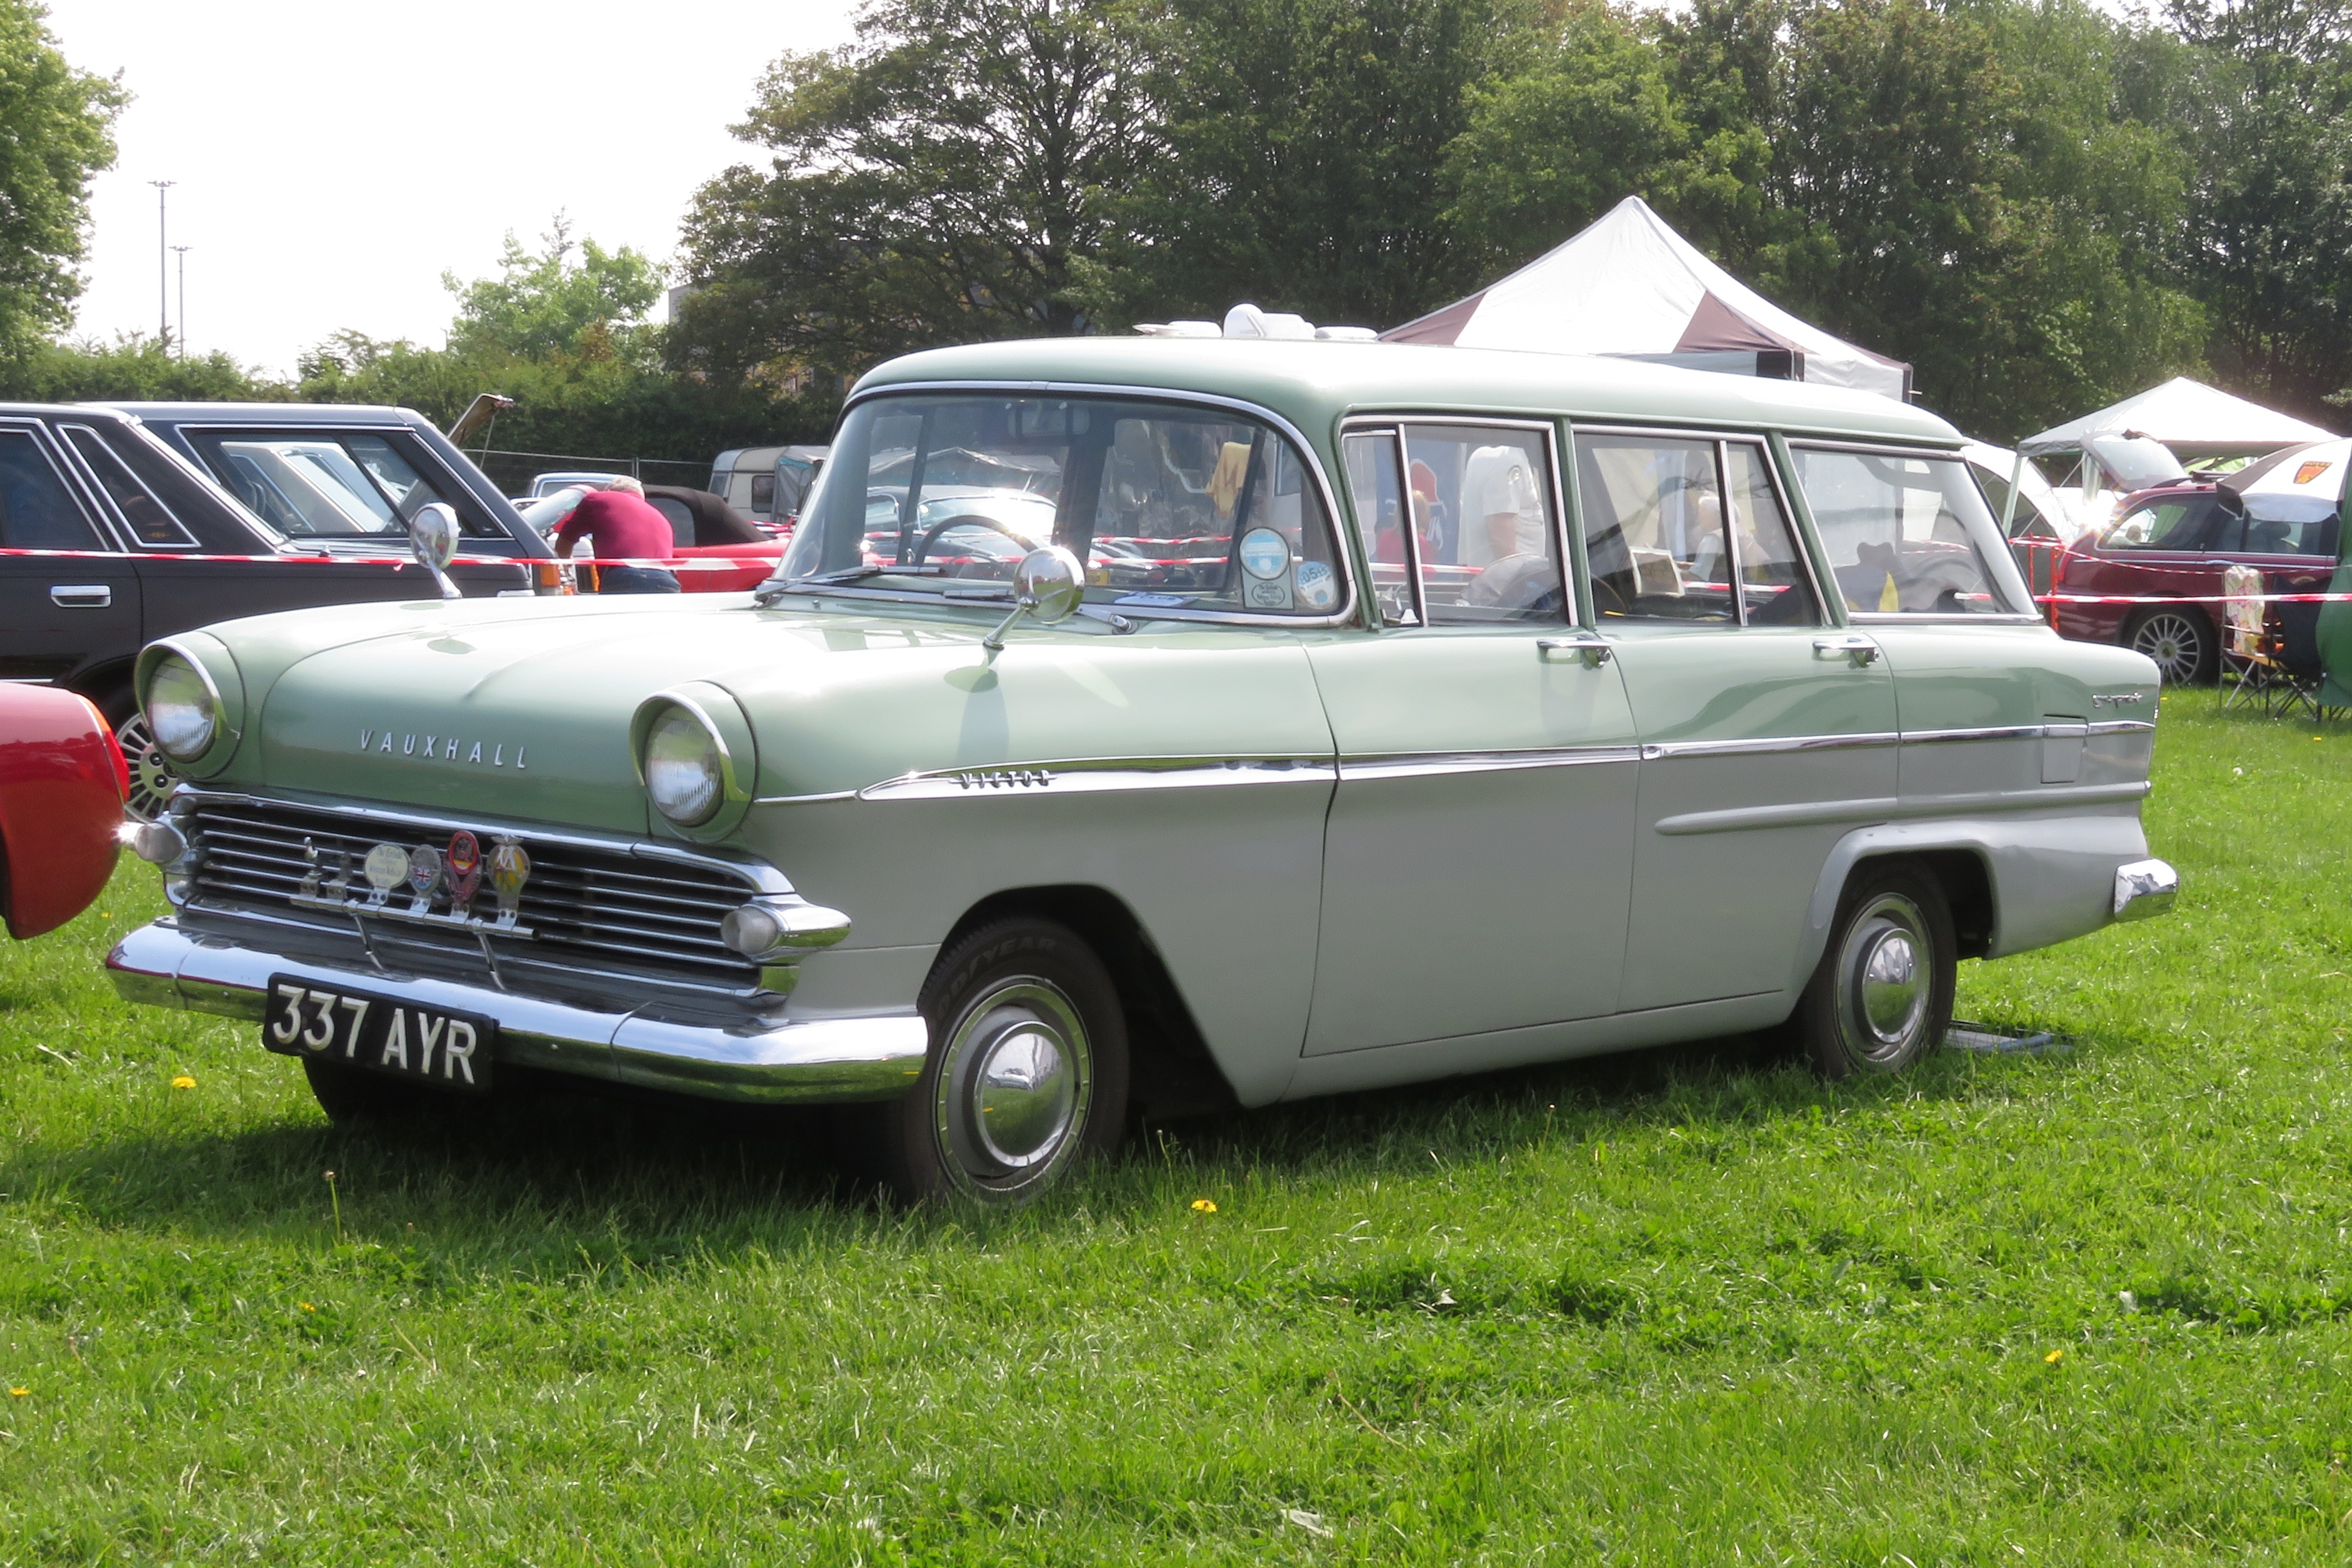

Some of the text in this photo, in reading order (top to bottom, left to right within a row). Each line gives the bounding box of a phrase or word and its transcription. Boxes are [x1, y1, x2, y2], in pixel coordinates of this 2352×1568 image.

[360, 729, 527, 769] VAUXHALL
[960, 769, 1050, 789] VICTOR
[272, 983, 477, 1085] 337 AYR
